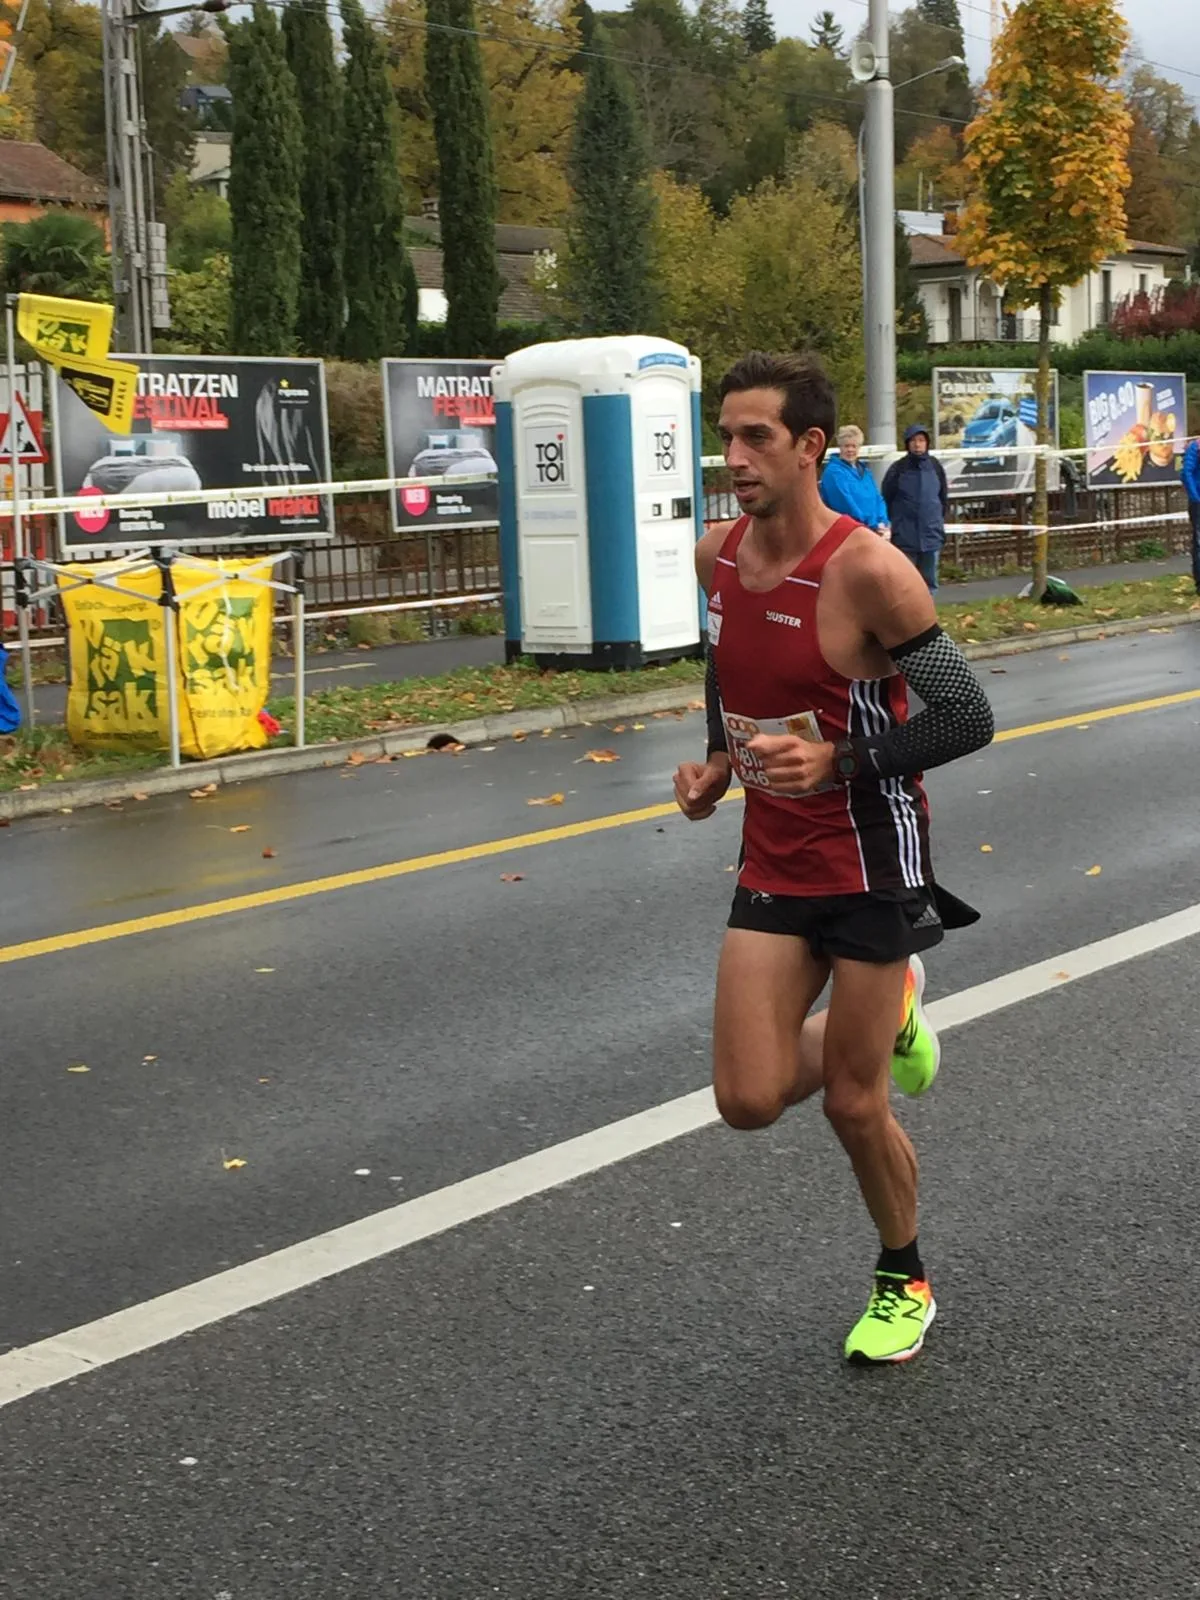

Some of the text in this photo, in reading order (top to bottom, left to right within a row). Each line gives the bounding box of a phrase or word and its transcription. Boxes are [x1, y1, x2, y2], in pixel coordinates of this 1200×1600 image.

[136, 373, 239, 398] TRATZEN
[417, 376, 492, 397] MATRAT
[133, 396, 225, 419] ESTIVAL
[433, 396, 494, 417] FESTIV
[654, 432, 676, 451] TOI
[535, 442, 564, 462] TOI
[655, 452, 676, 471] TOI
[536, 462, 565, 482] TOI
